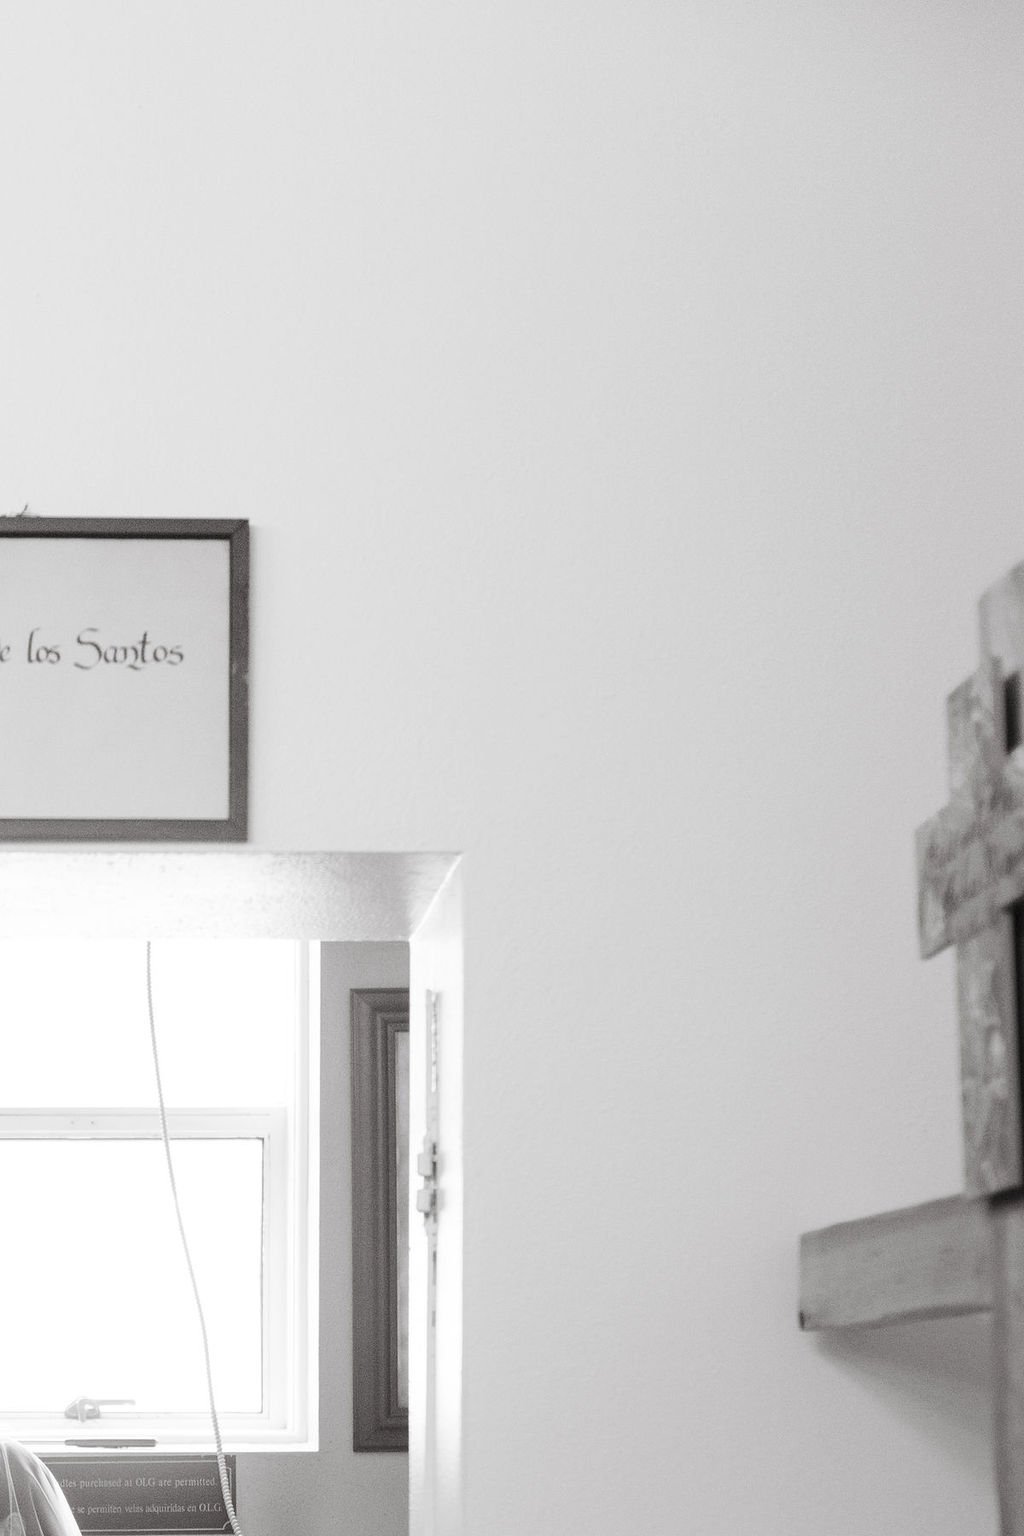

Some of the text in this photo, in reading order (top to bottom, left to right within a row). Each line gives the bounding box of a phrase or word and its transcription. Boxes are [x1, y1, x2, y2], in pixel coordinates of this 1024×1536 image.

[27, 626, 61, 665] los
[73, 627, 185, 671] Santos
[80, 1478, 122, 1490] purchased
[124, 1478, 133, 1488] at
[158, 1478, 172, 1488] are
[87, 1503, 122, 1516] permiten
[124, 1503, 144, 1513] velas
[146, 1503, 185, 1515] adquiridas
[187, 1504, 197, 1513] en
